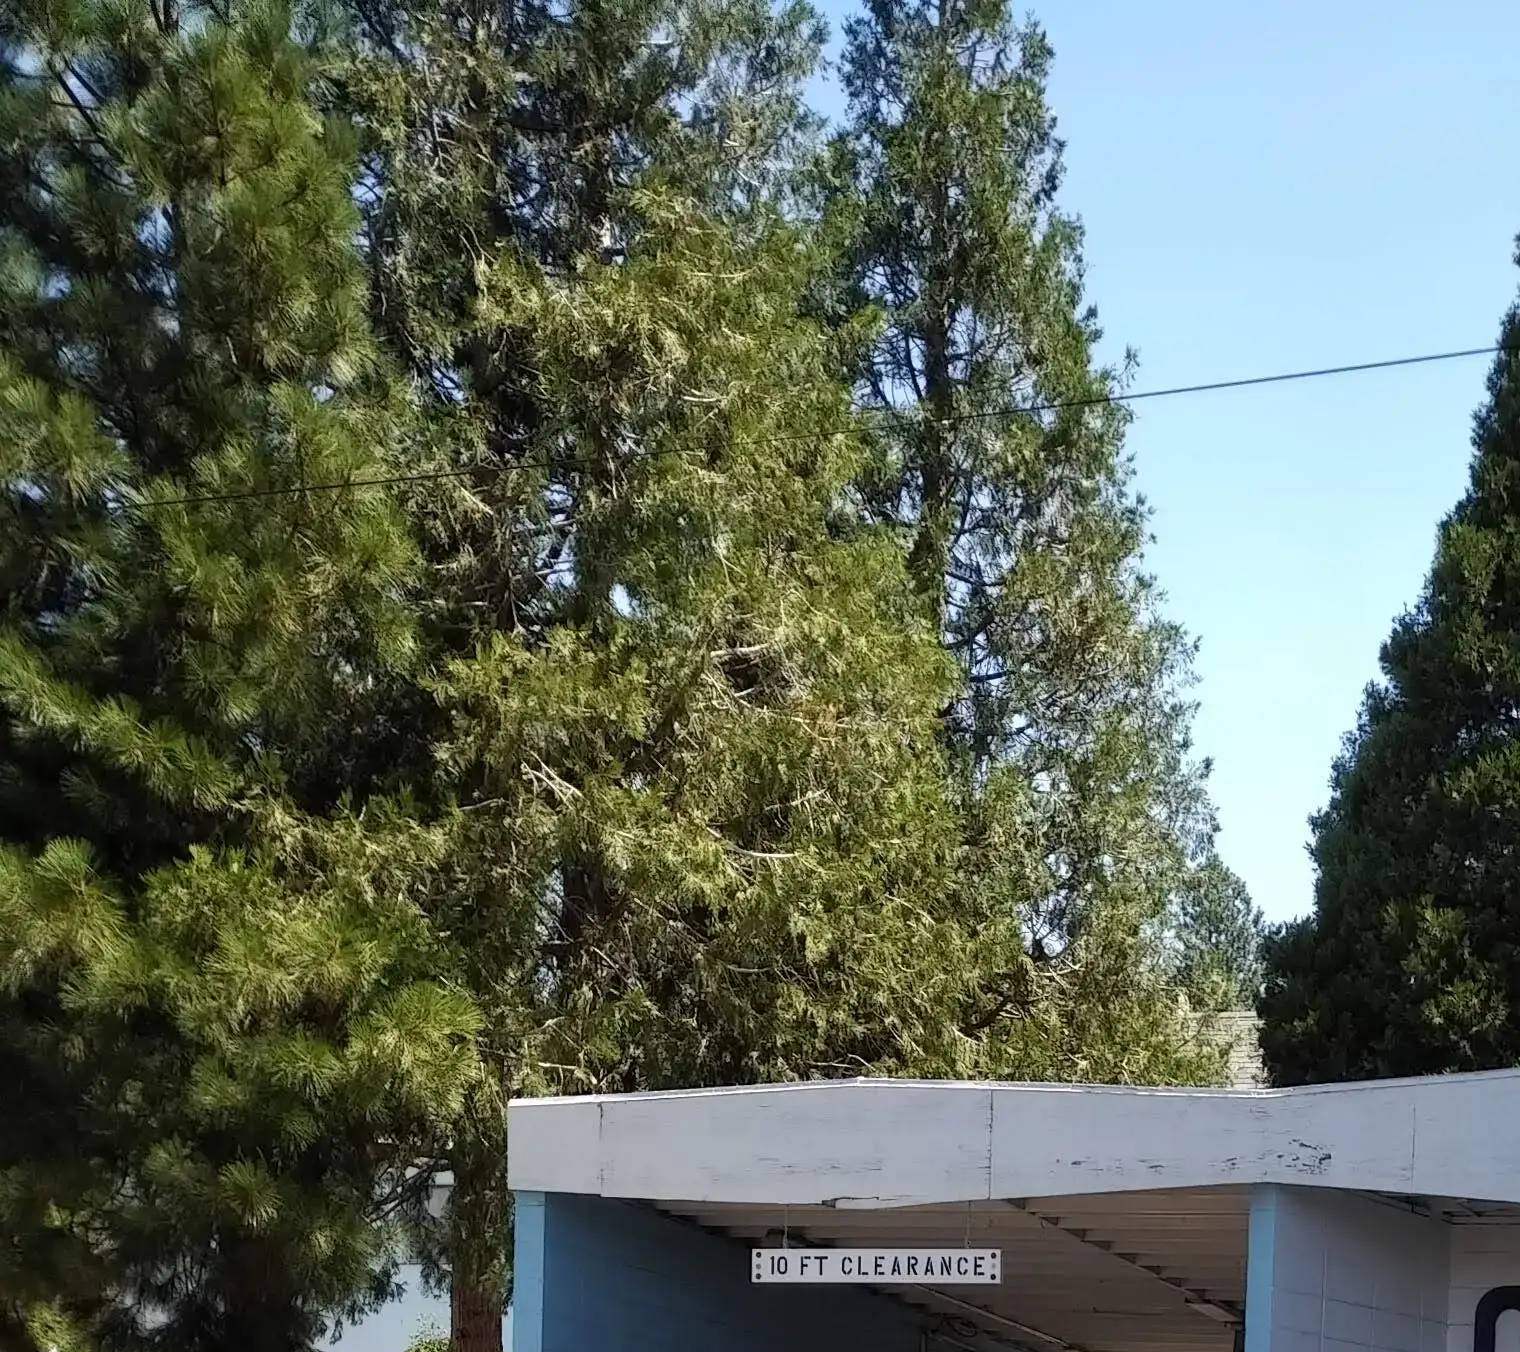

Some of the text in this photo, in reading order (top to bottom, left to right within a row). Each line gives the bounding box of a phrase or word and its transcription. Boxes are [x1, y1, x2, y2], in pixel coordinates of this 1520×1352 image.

[769, 1255, 986, 1277] 10 FT CLEARANCE
